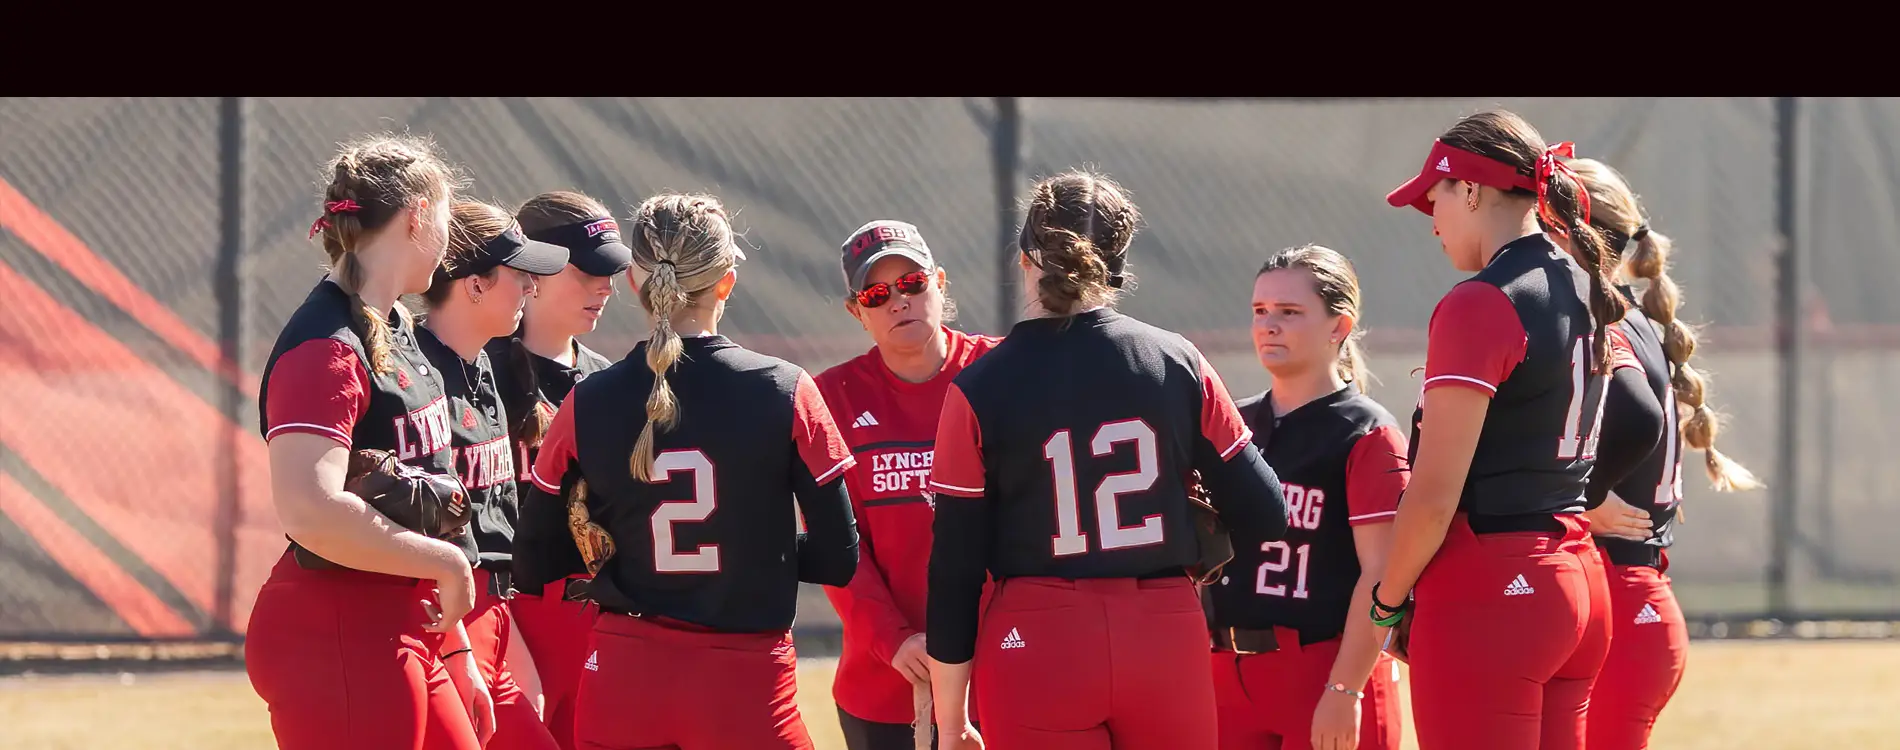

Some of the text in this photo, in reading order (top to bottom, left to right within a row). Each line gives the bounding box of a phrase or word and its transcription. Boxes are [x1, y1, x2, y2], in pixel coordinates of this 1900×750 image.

[872, 451, 935, 472] LYNCH
[1654, 383, 1683, 504] 1
[872, 469, 933, 493] SOFT
[1043, 417, 1165, 557] 12
[1279, 481, 1325, 530] RG
[649, 448, 721, 573] 2
[1256, 539, 1311, 599] 21
[1504, 587, 1535, 596] adidas
[1000, 640, 1026, 649] adidas
